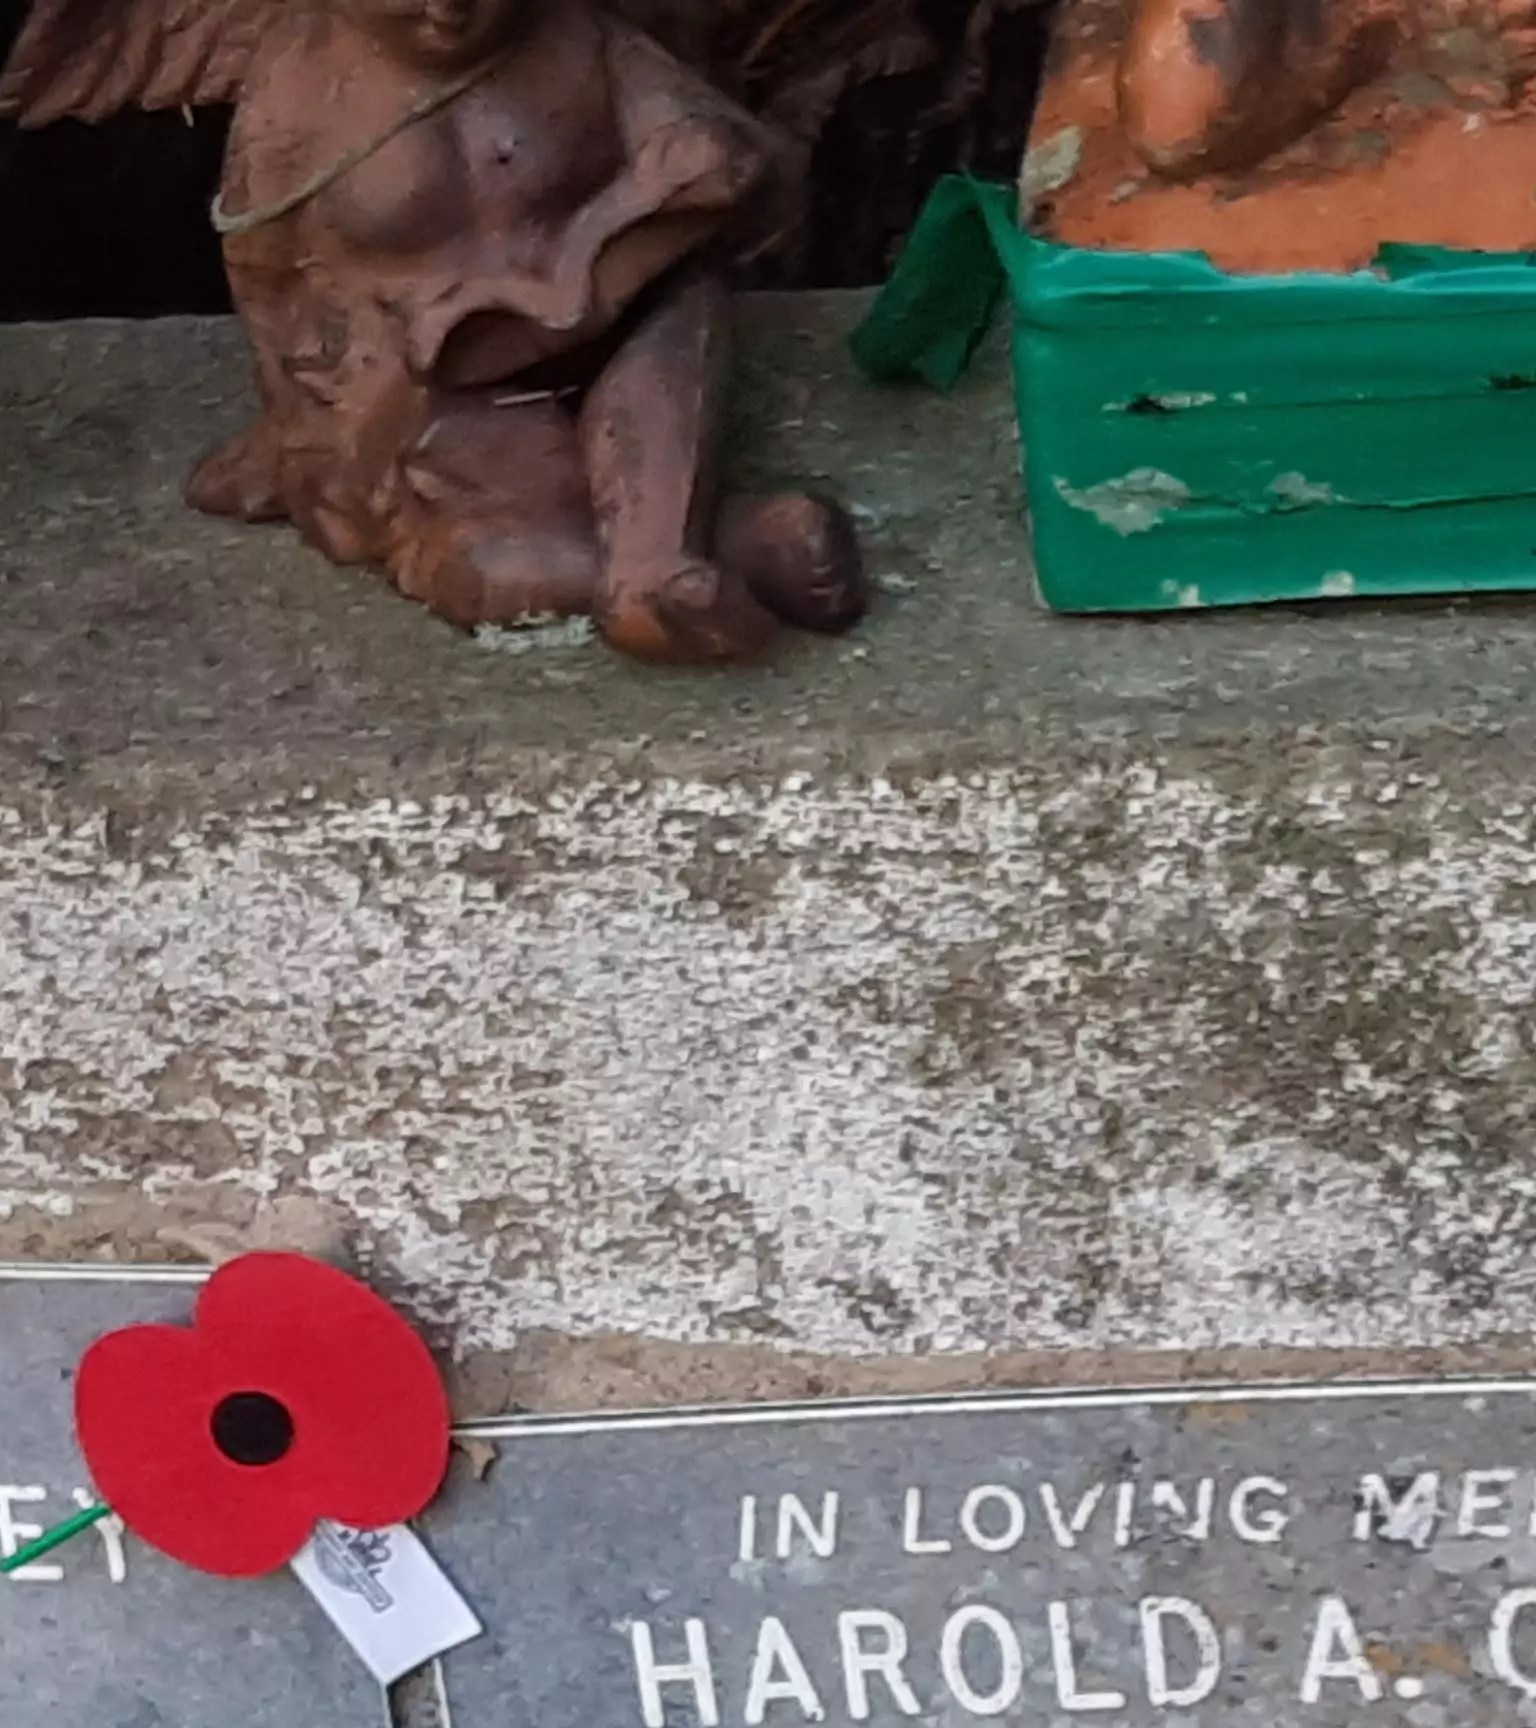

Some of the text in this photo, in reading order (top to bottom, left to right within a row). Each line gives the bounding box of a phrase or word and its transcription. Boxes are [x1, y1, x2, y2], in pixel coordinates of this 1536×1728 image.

[738, 1490, 839, 1563] IN
[902, 1475, 1290, 1554] LOVING
[1298, 1597, 1425, 1704] A.
